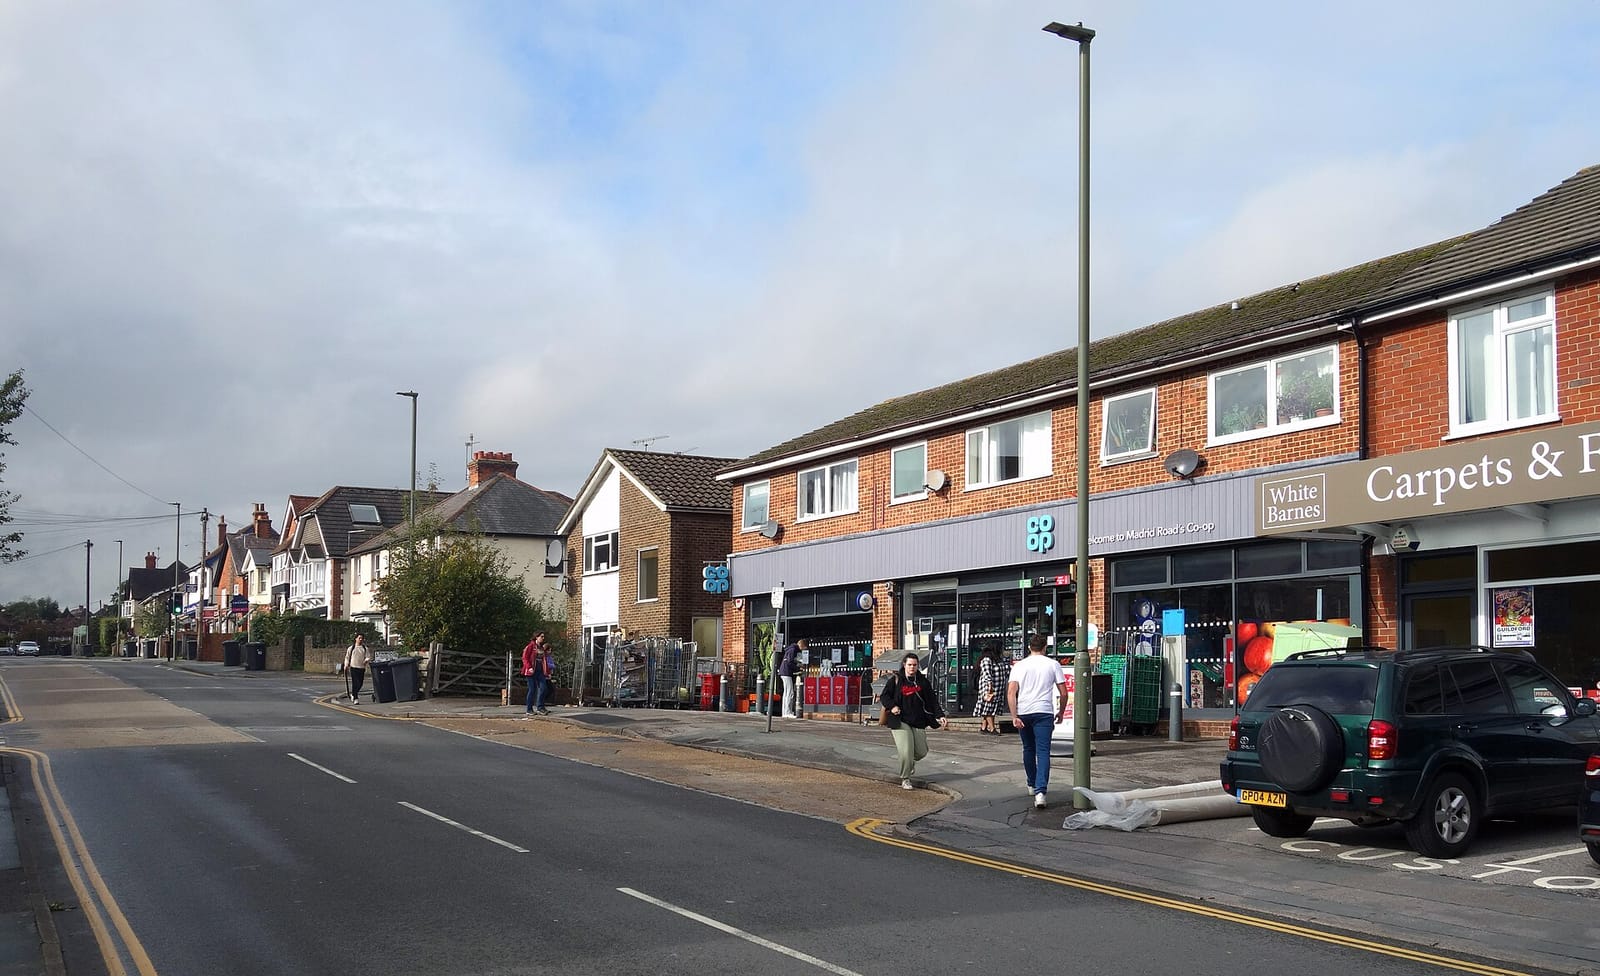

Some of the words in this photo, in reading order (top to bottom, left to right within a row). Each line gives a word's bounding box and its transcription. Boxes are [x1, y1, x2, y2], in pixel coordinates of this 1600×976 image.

[1366, 454, 1513, 506] Carpets
[1527, 441, 1565, 480] &
[1269, 484, 1318, 504] White
[1266, 504, 1321, 523] Barnes
[1088, 534, 1115, 545] elcome
[1116, 533, 1125, 542] to
[1126, 528, 1155, 541] Madrid
[1157, 523, 1185, 537] Road's
[1186, 521, 1216, 534] Co-op
[1242, 790, 1264, 803] GP04
[1267, 793, 1285, 806] AZN
